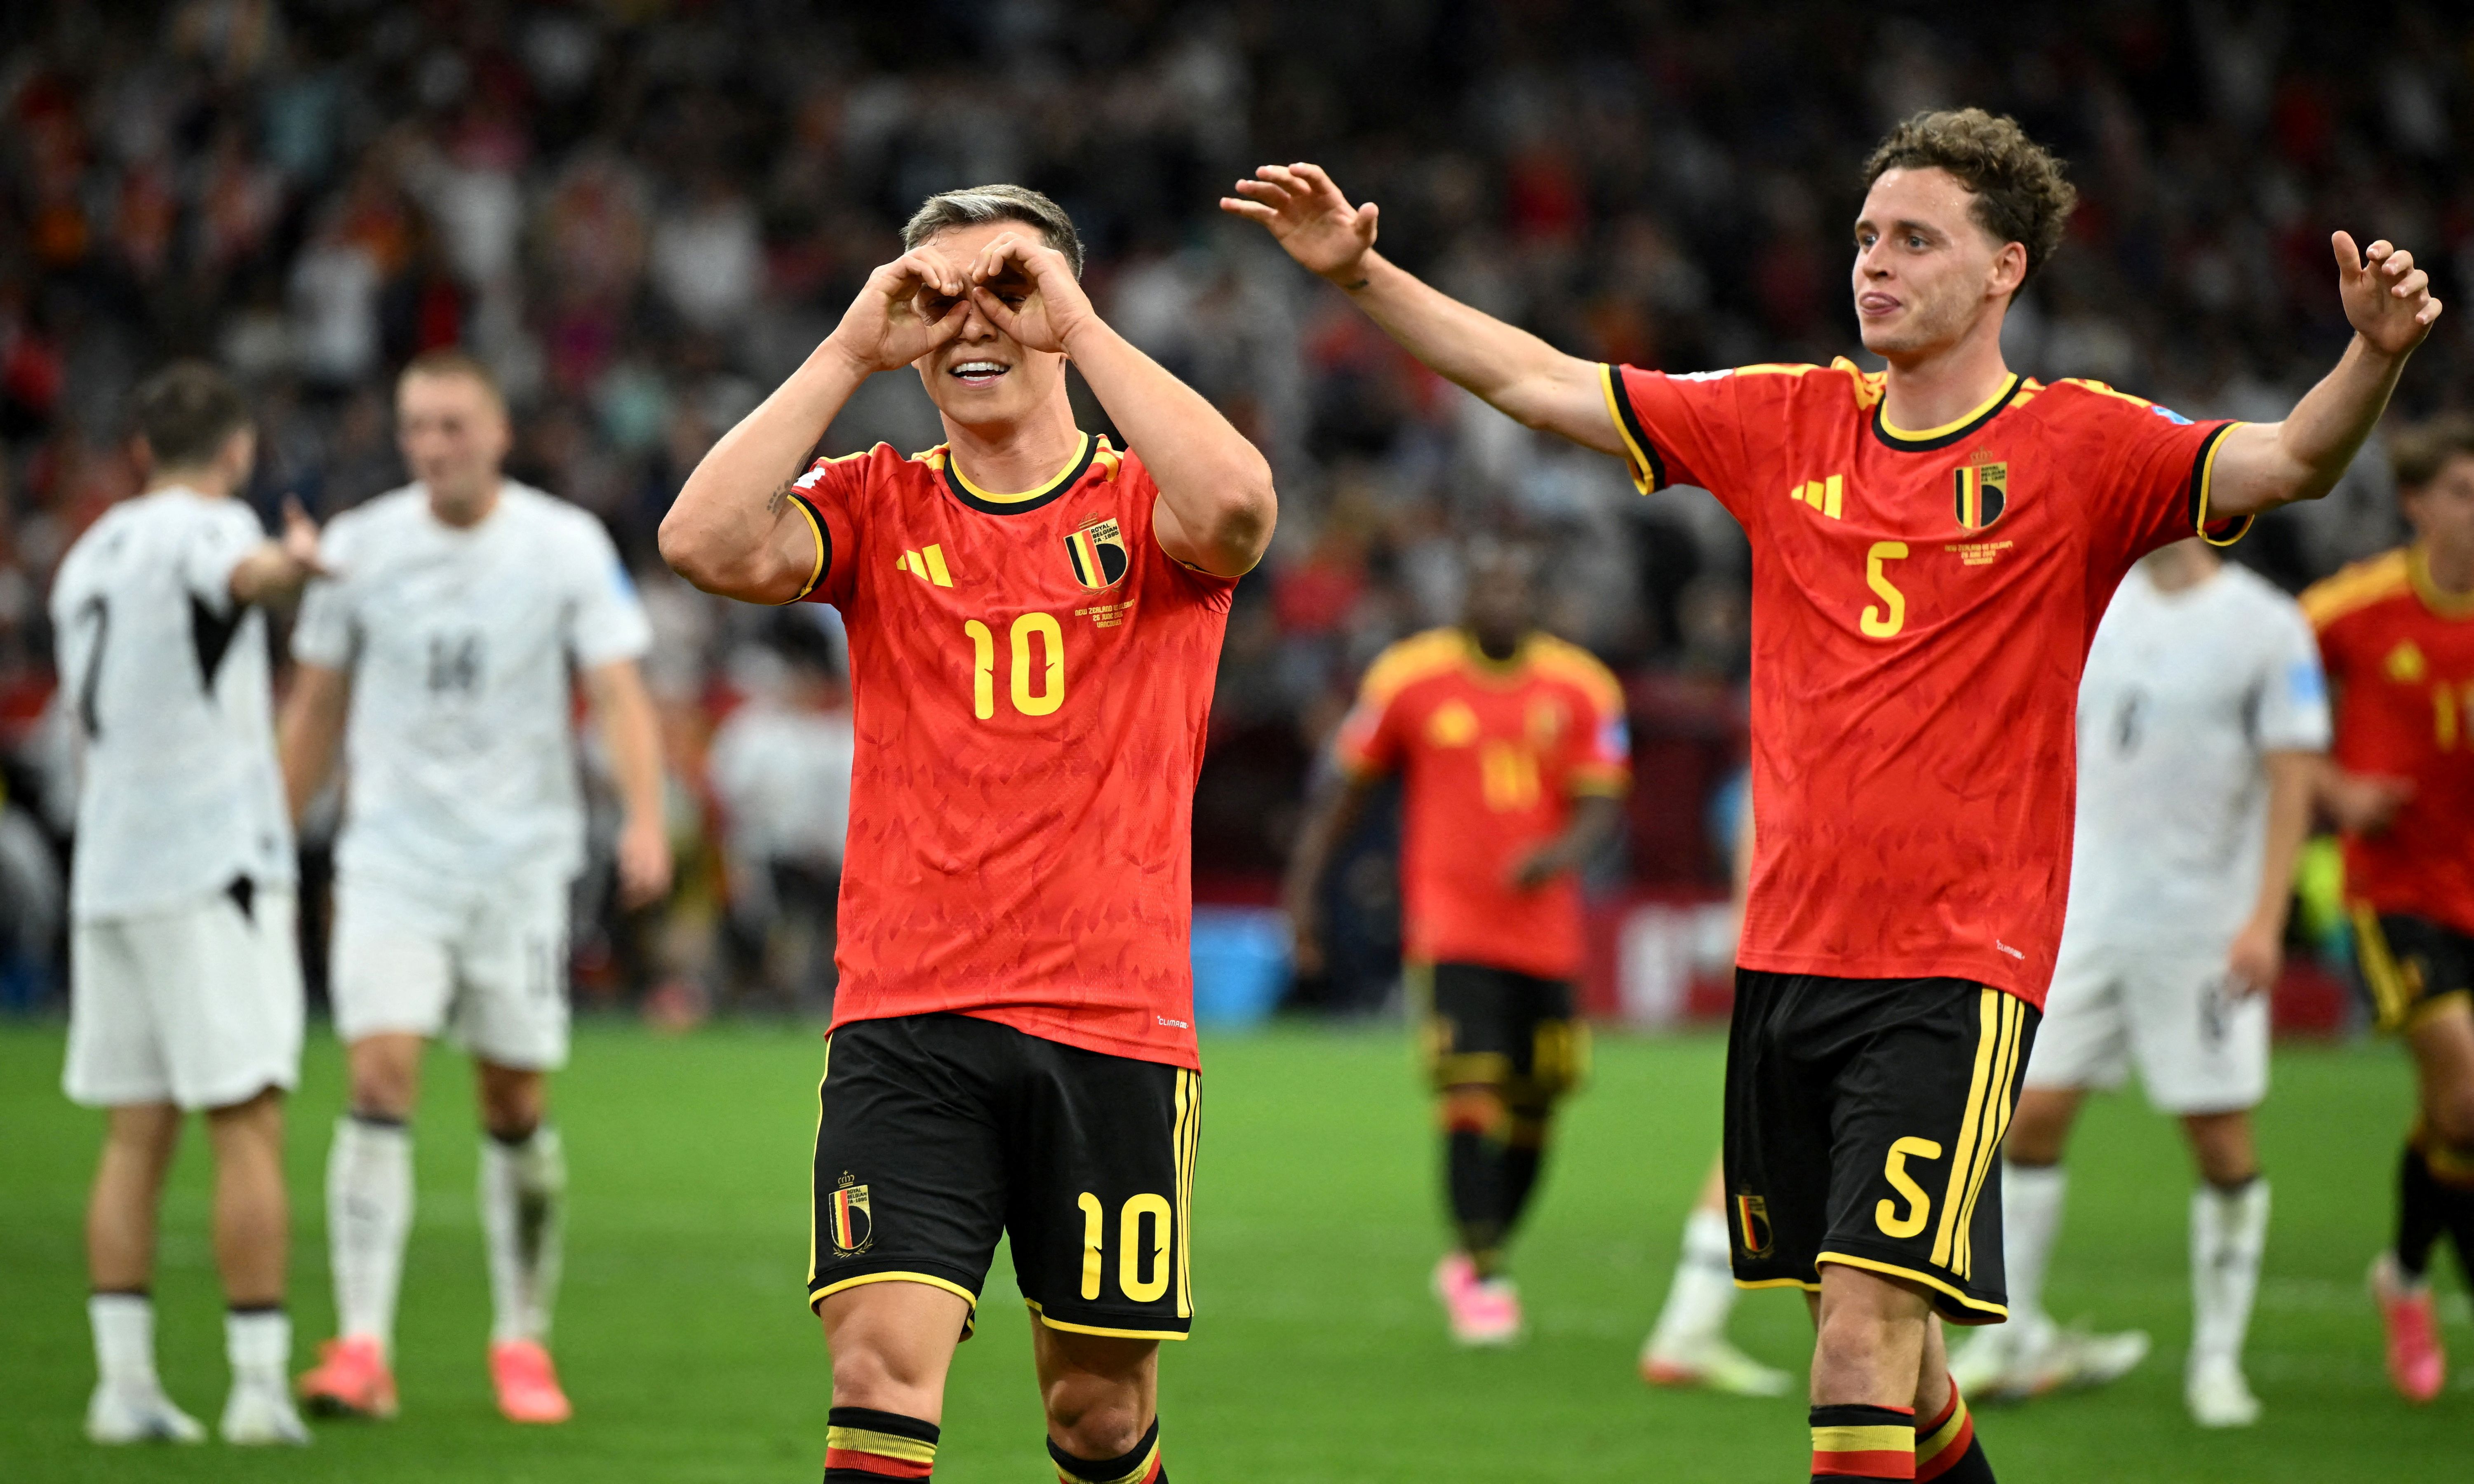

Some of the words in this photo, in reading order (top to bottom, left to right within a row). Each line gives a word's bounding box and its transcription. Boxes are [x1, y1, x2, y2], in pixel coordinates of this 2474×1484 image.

[1091, 523, 1110, 534] ROYAL
[1092, 525, 1117, 539] BELGIAN
[1088, 605, 1112, 615] ZEALAND
[1860, 541, 1909, 638] 5
[964, 612, 1065, 719] 10
[1875, 1136, 1942, 1238] 5
[1078, 1192, 1171, 1302] 10
